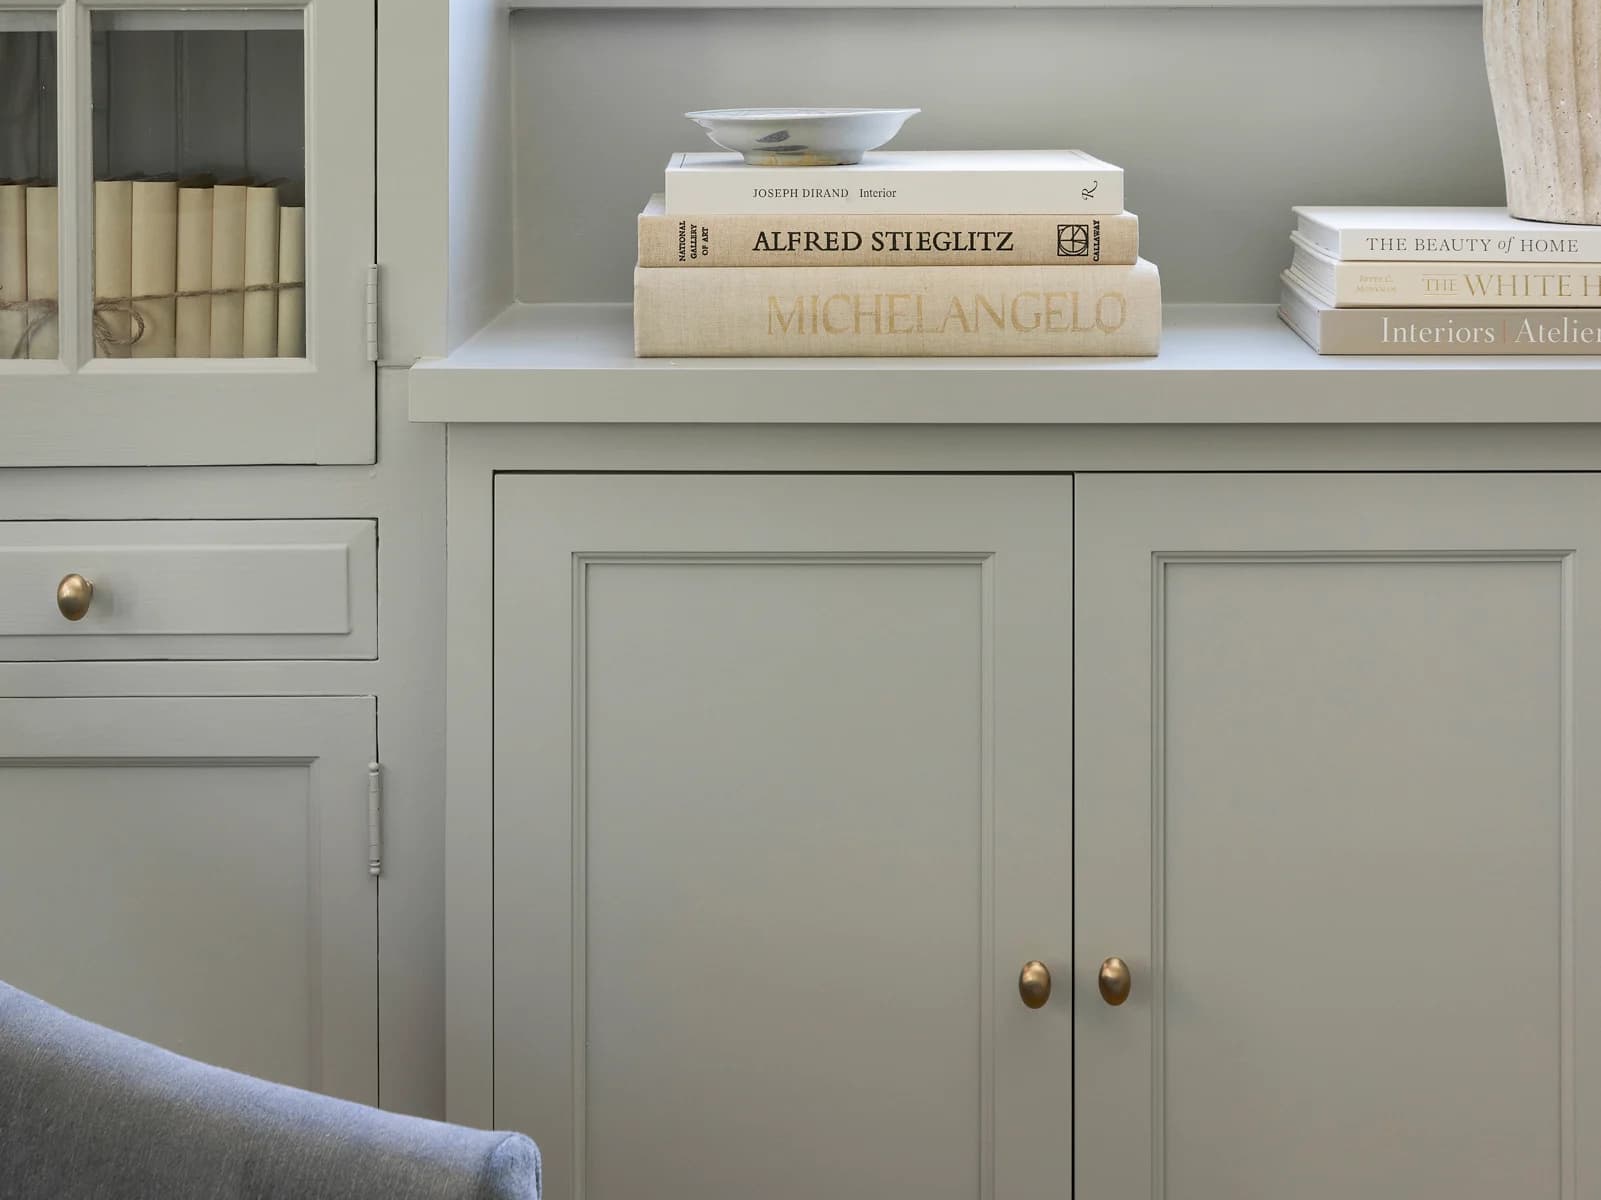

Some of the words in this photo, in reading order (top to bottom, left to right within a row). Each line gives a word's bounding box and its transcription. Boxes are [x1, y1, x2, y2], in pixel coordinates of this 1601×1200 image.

[752, 188, 798, 198] JOSEPH
[802, 188, 849, 198] DIRAND
[859, 187, 897, 198] Interior
[678, 220, 687, 262] NATIONAL
[690, 223, 698, 260] GALLERY
[701, 226, 709, 243] ART
[752, 231, 863, 252] ALFRED
[871, 231, 1014, 252] STIEGLITZ
[1092, 219, 1101, 262] CALLAWAY
[1366, 237, 1407, 251] THE
[1415, 238, 1491, 252] BEAUTY
[1497, 236, 1516, 254] of
[1521, 239, 1579, 253] HOME
[701, 244, 709, 256] OF
[1424, 278, 1457, 292] THE
[1464, 274, 1572, 297] WHITE
[767, 291, 1128, 336] MICHELANGELO
[1382, 316, 1495, 344] Interiors
